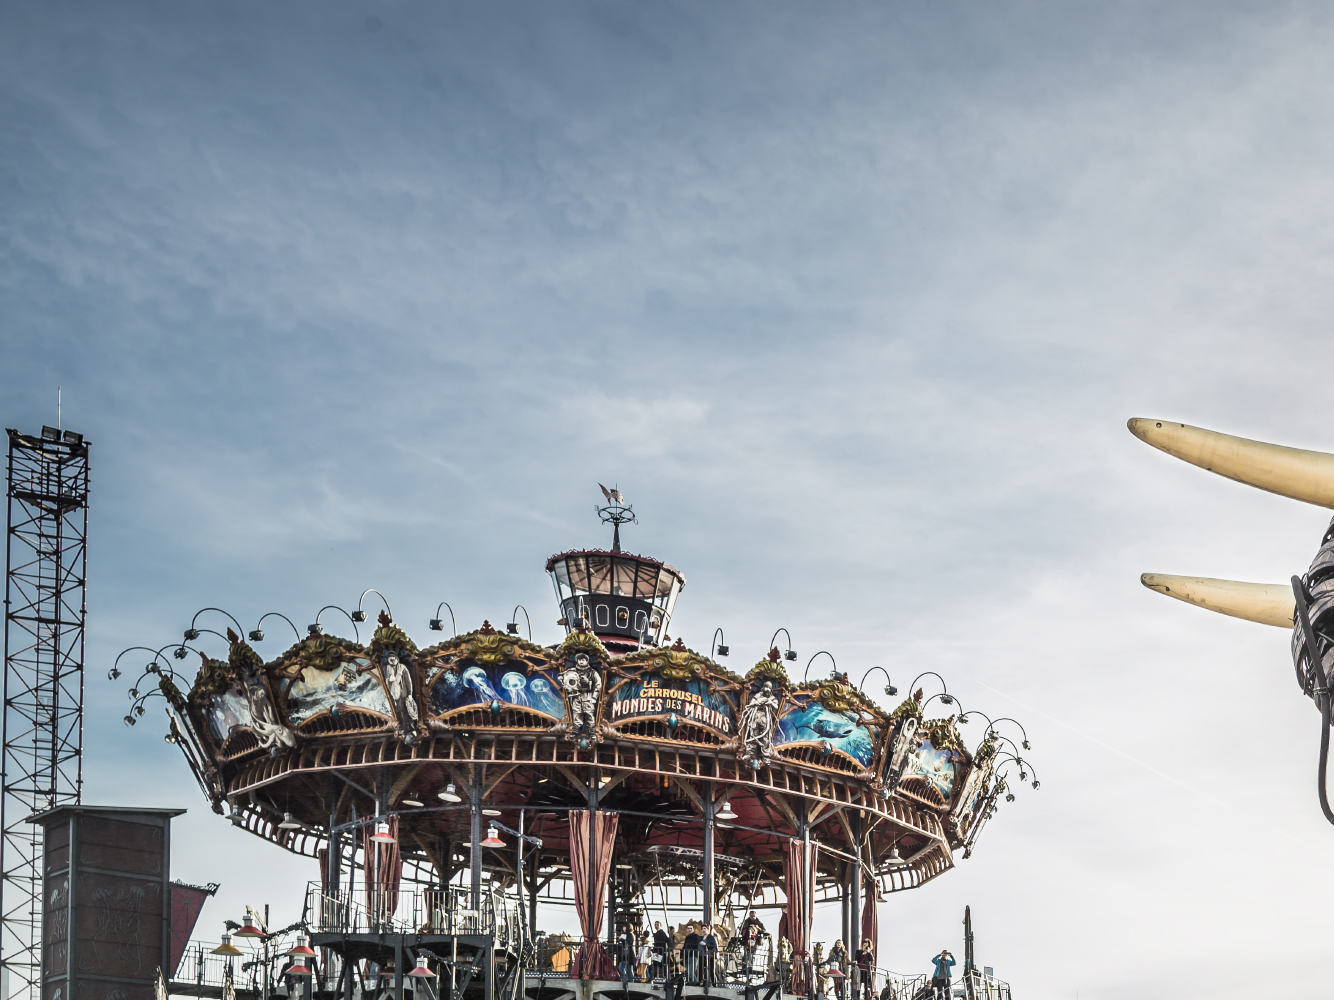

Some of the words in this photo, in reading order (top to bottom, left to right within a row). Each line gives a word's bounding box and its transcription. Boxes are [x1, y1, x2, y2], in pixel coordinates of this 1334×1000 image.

[643, 680, 659, 688] LE
[640, 688, 705, 707] CARROUSEL
[611, 698, 664, 719] MONDES
[666, 699, 681, 710] DES
[683, 702, 730, 733] MARINS
